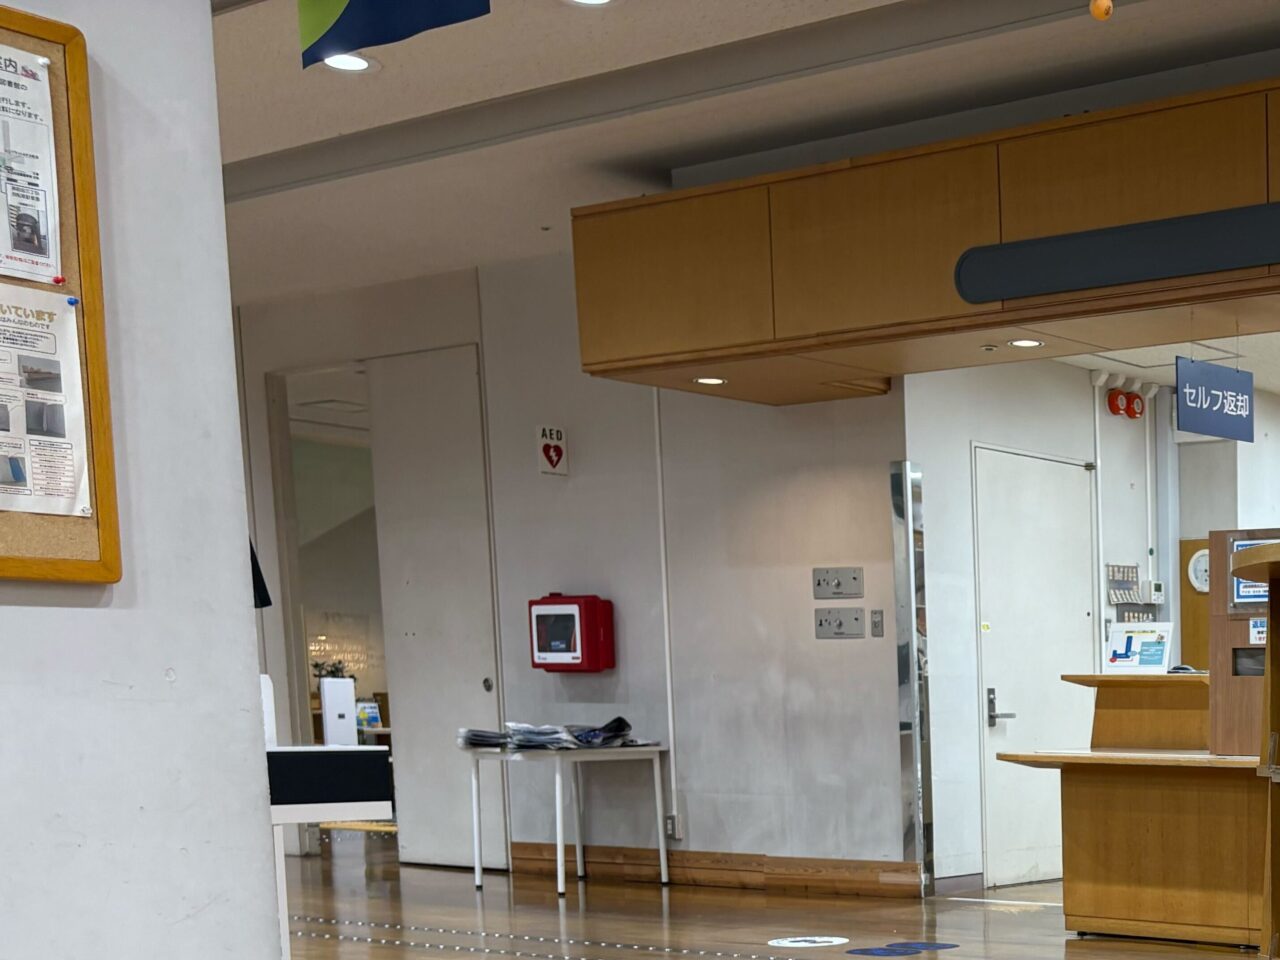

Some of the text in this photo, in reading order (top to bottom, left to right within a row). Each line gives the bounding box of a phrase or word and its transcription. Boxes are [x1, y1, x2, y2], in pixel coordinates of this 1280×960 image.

[1183, 383, 1249, 418] セルフ返却
[541, 427, 563, 441] AED
